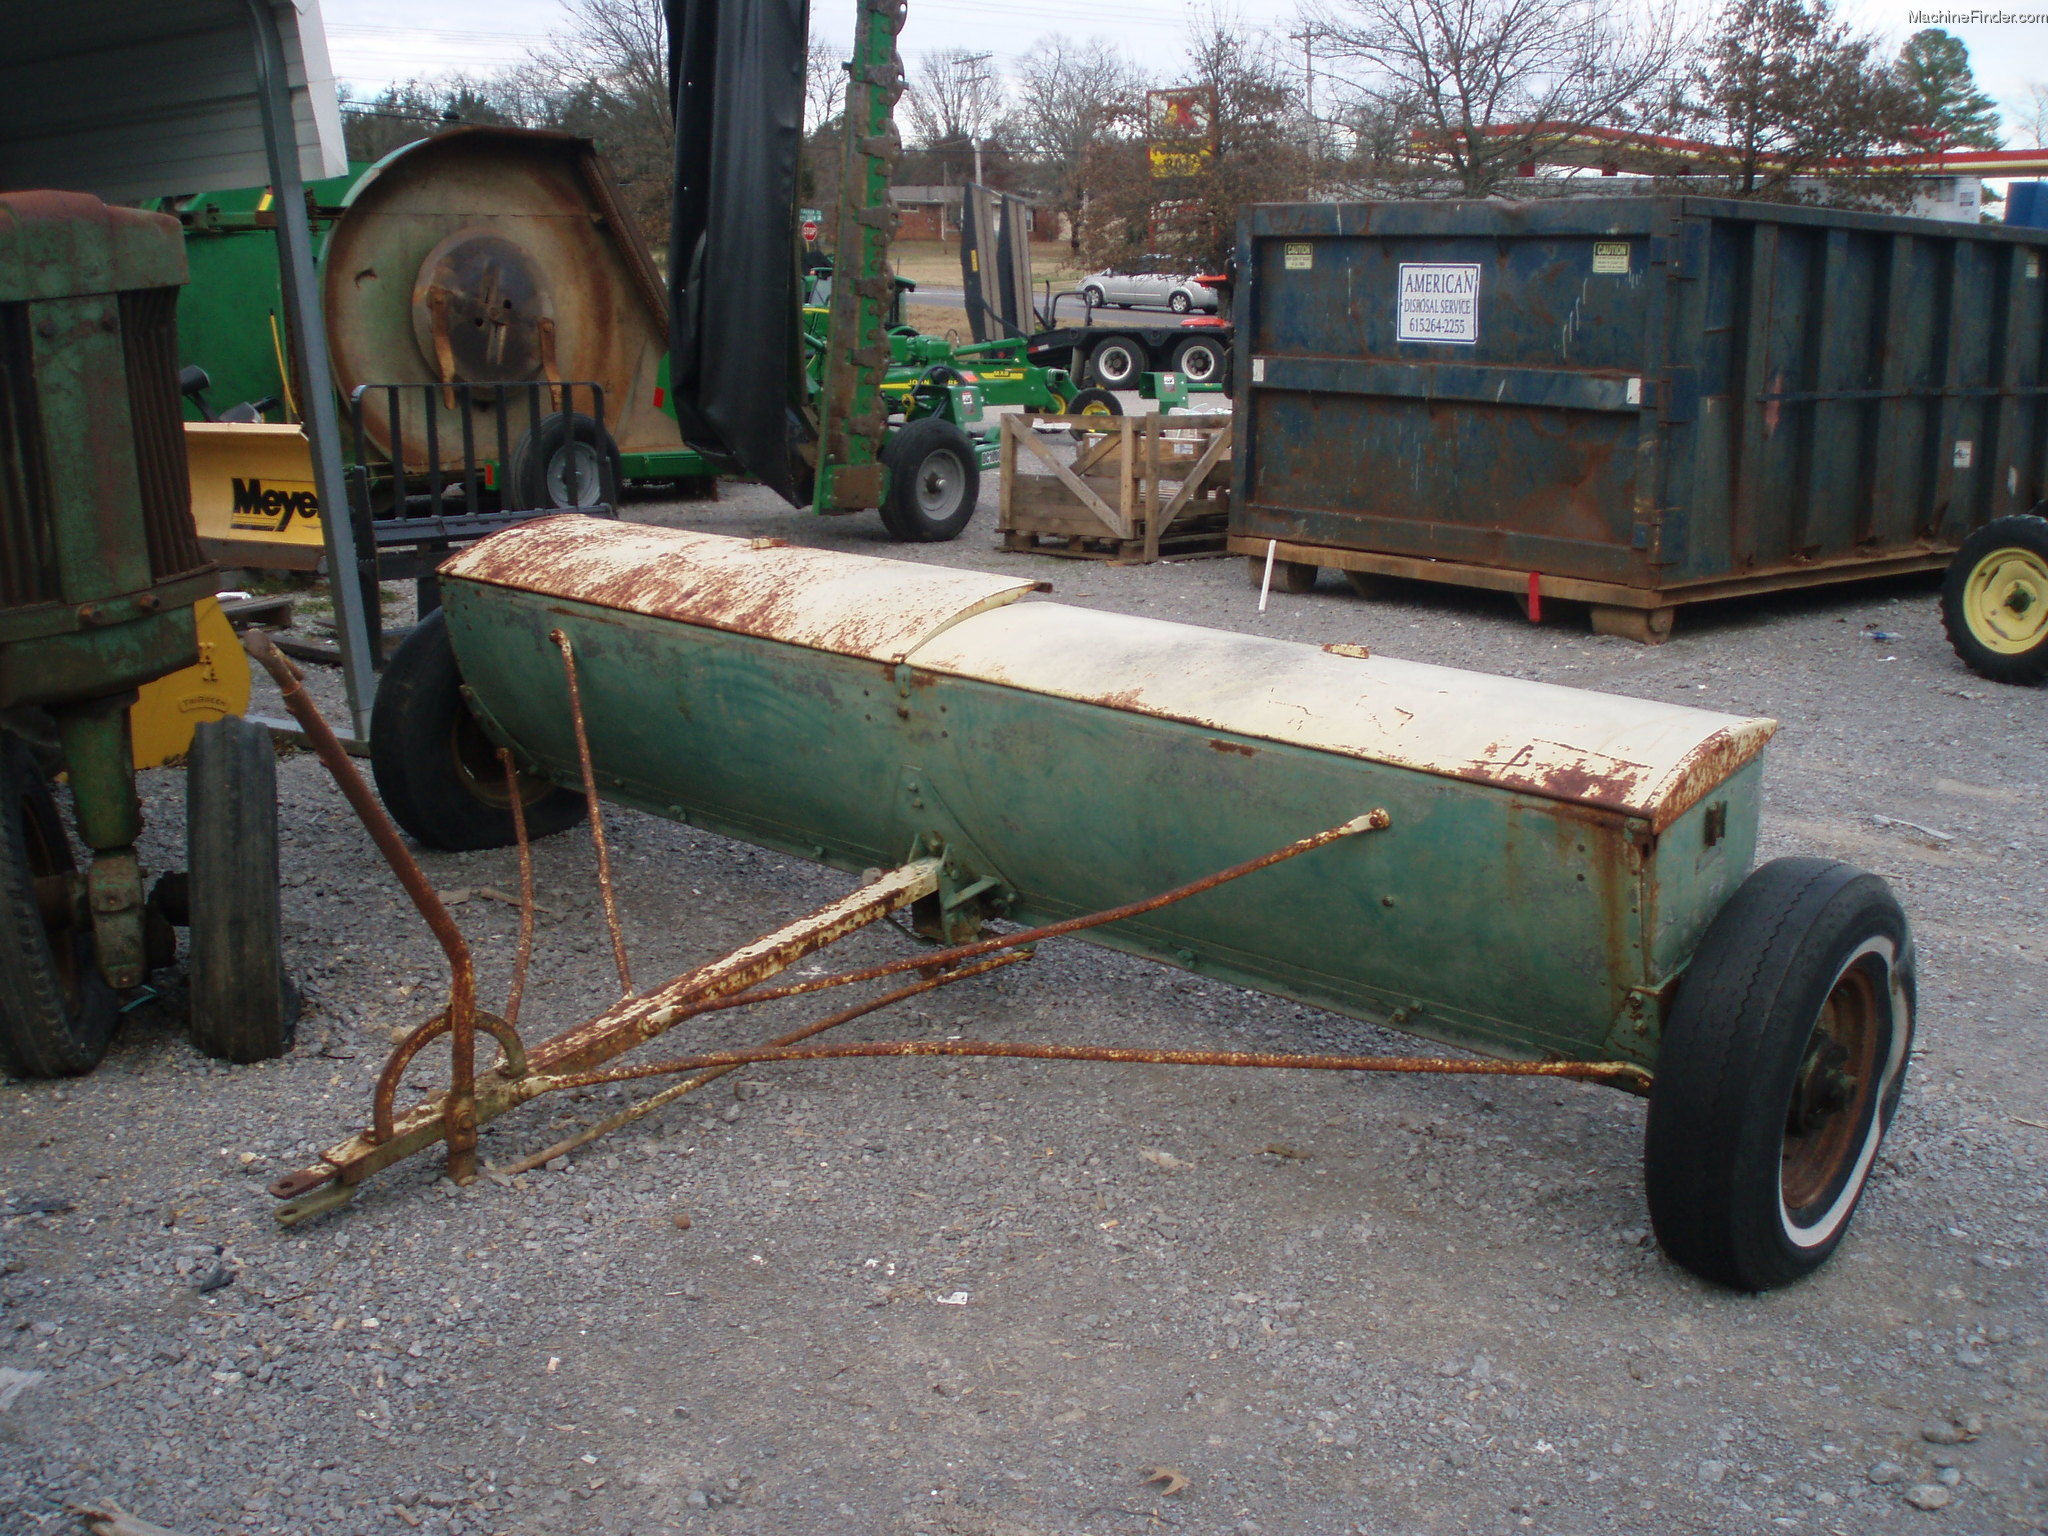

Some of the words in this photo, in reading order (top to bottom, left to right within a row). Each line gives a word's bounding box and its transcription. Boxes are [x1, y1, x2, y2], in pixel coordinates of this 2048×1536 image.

[803, 227, 817, 235] STOP
[1598, 244, 1627, 255] CAUTION
[1405, 272, 1474, 293] AMERICAN
[1404, 298, 1439, 314] DISPOSAL
[1440, 299, 1471, 315] SERVICE
[231, 477, 320, 532] Meye
